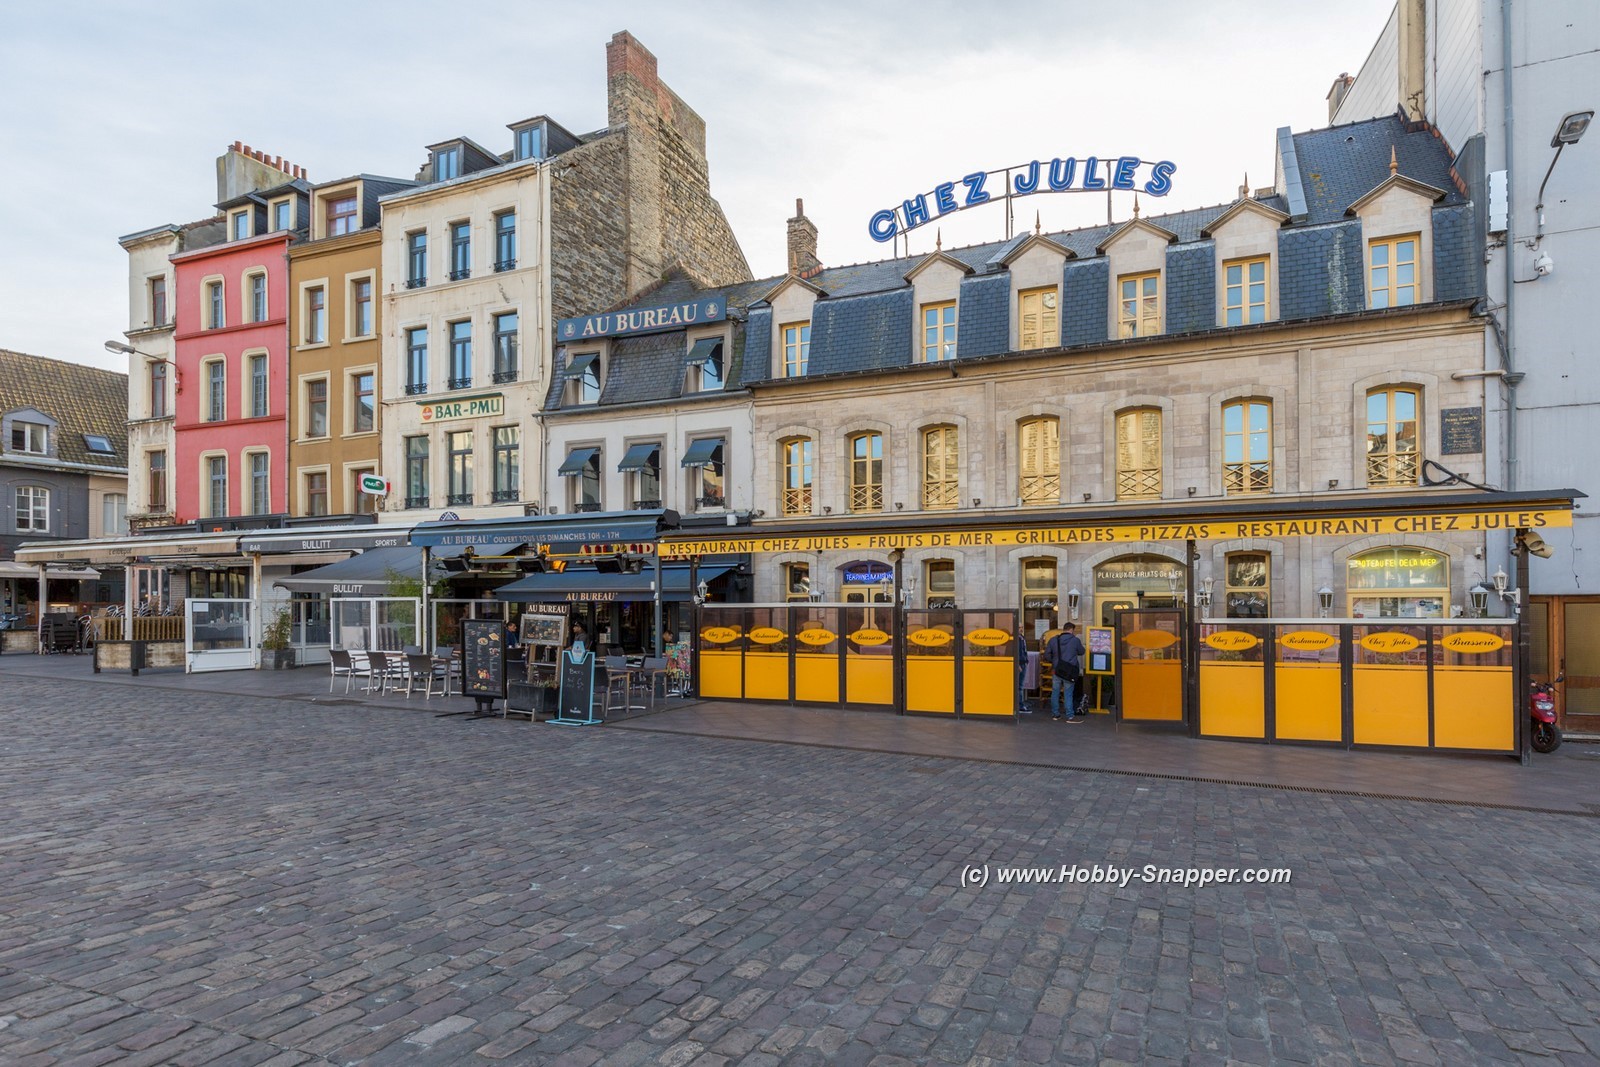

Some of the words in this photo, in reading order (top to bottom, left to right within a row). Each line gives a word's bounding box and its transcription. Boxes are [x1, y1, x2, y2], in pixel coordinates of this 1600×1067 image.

[868, 171, 990, 243] CHEZ
[1014, 156, 1177, 196] JULES
[582, 316, 610, 337] AU
[616, 304, 698, 332] BUREAU
[435, 398, 500, 419] BAR-PMU
[669, 541, 756, 555] RESTAURANT
[762, 539, 800, 551] CHEZ
[806, 537, 849, 550] JULES
[869, 535, 923, 548] FRUITS
[931, 534, 951, 546] DE
[958, 533, 993, 545] MER
[1015, 528, 1115, 543] GRILLADES
[1140, 525, 1209, 540] PIZZAS
[1237, 518, 1382, 537] RESTAURANT
[1394, 515, 1460, 532] CHEZ
[1470, 512, 1547, 529] JULES
[441, 535, 453, 545] AU
[455, 535, 489, 545] BUREAU
[493, 536, 518, 544] OUVERT
[519, 535, 535, 543] TOUS
[536, 534, 546, 542] LES
[547, 533, 586, 541] DIMANCHES
[302, 540, 331, 549] BULLITT
[374, 539, 397, 547] SPORTS
[1137, 570, 1158, 578] FRUITS
[333, 584, 363, 593] BULLITT
[565, 592, 578, 601] AU
[580, 592, 615, 601] BUREAU
[528, 604, 538, 612] AU
[540, 605, 567, 614] BUREAU
[855, 633, 885, 641] Brasserie
[915, 634, 928, 642] Chez
[931, 634, 945, 642] Jules
[1211, 636, 1228, 645] Chez
[1232, 636, 1250, 645] Jules
[1287, 637, 1329, 645] Restaurant
[1367, 638, 1385, 647] Chez
[1390, 638, 1411, 647] Jules
[1449, 638, 1496, 646] Brasserie
